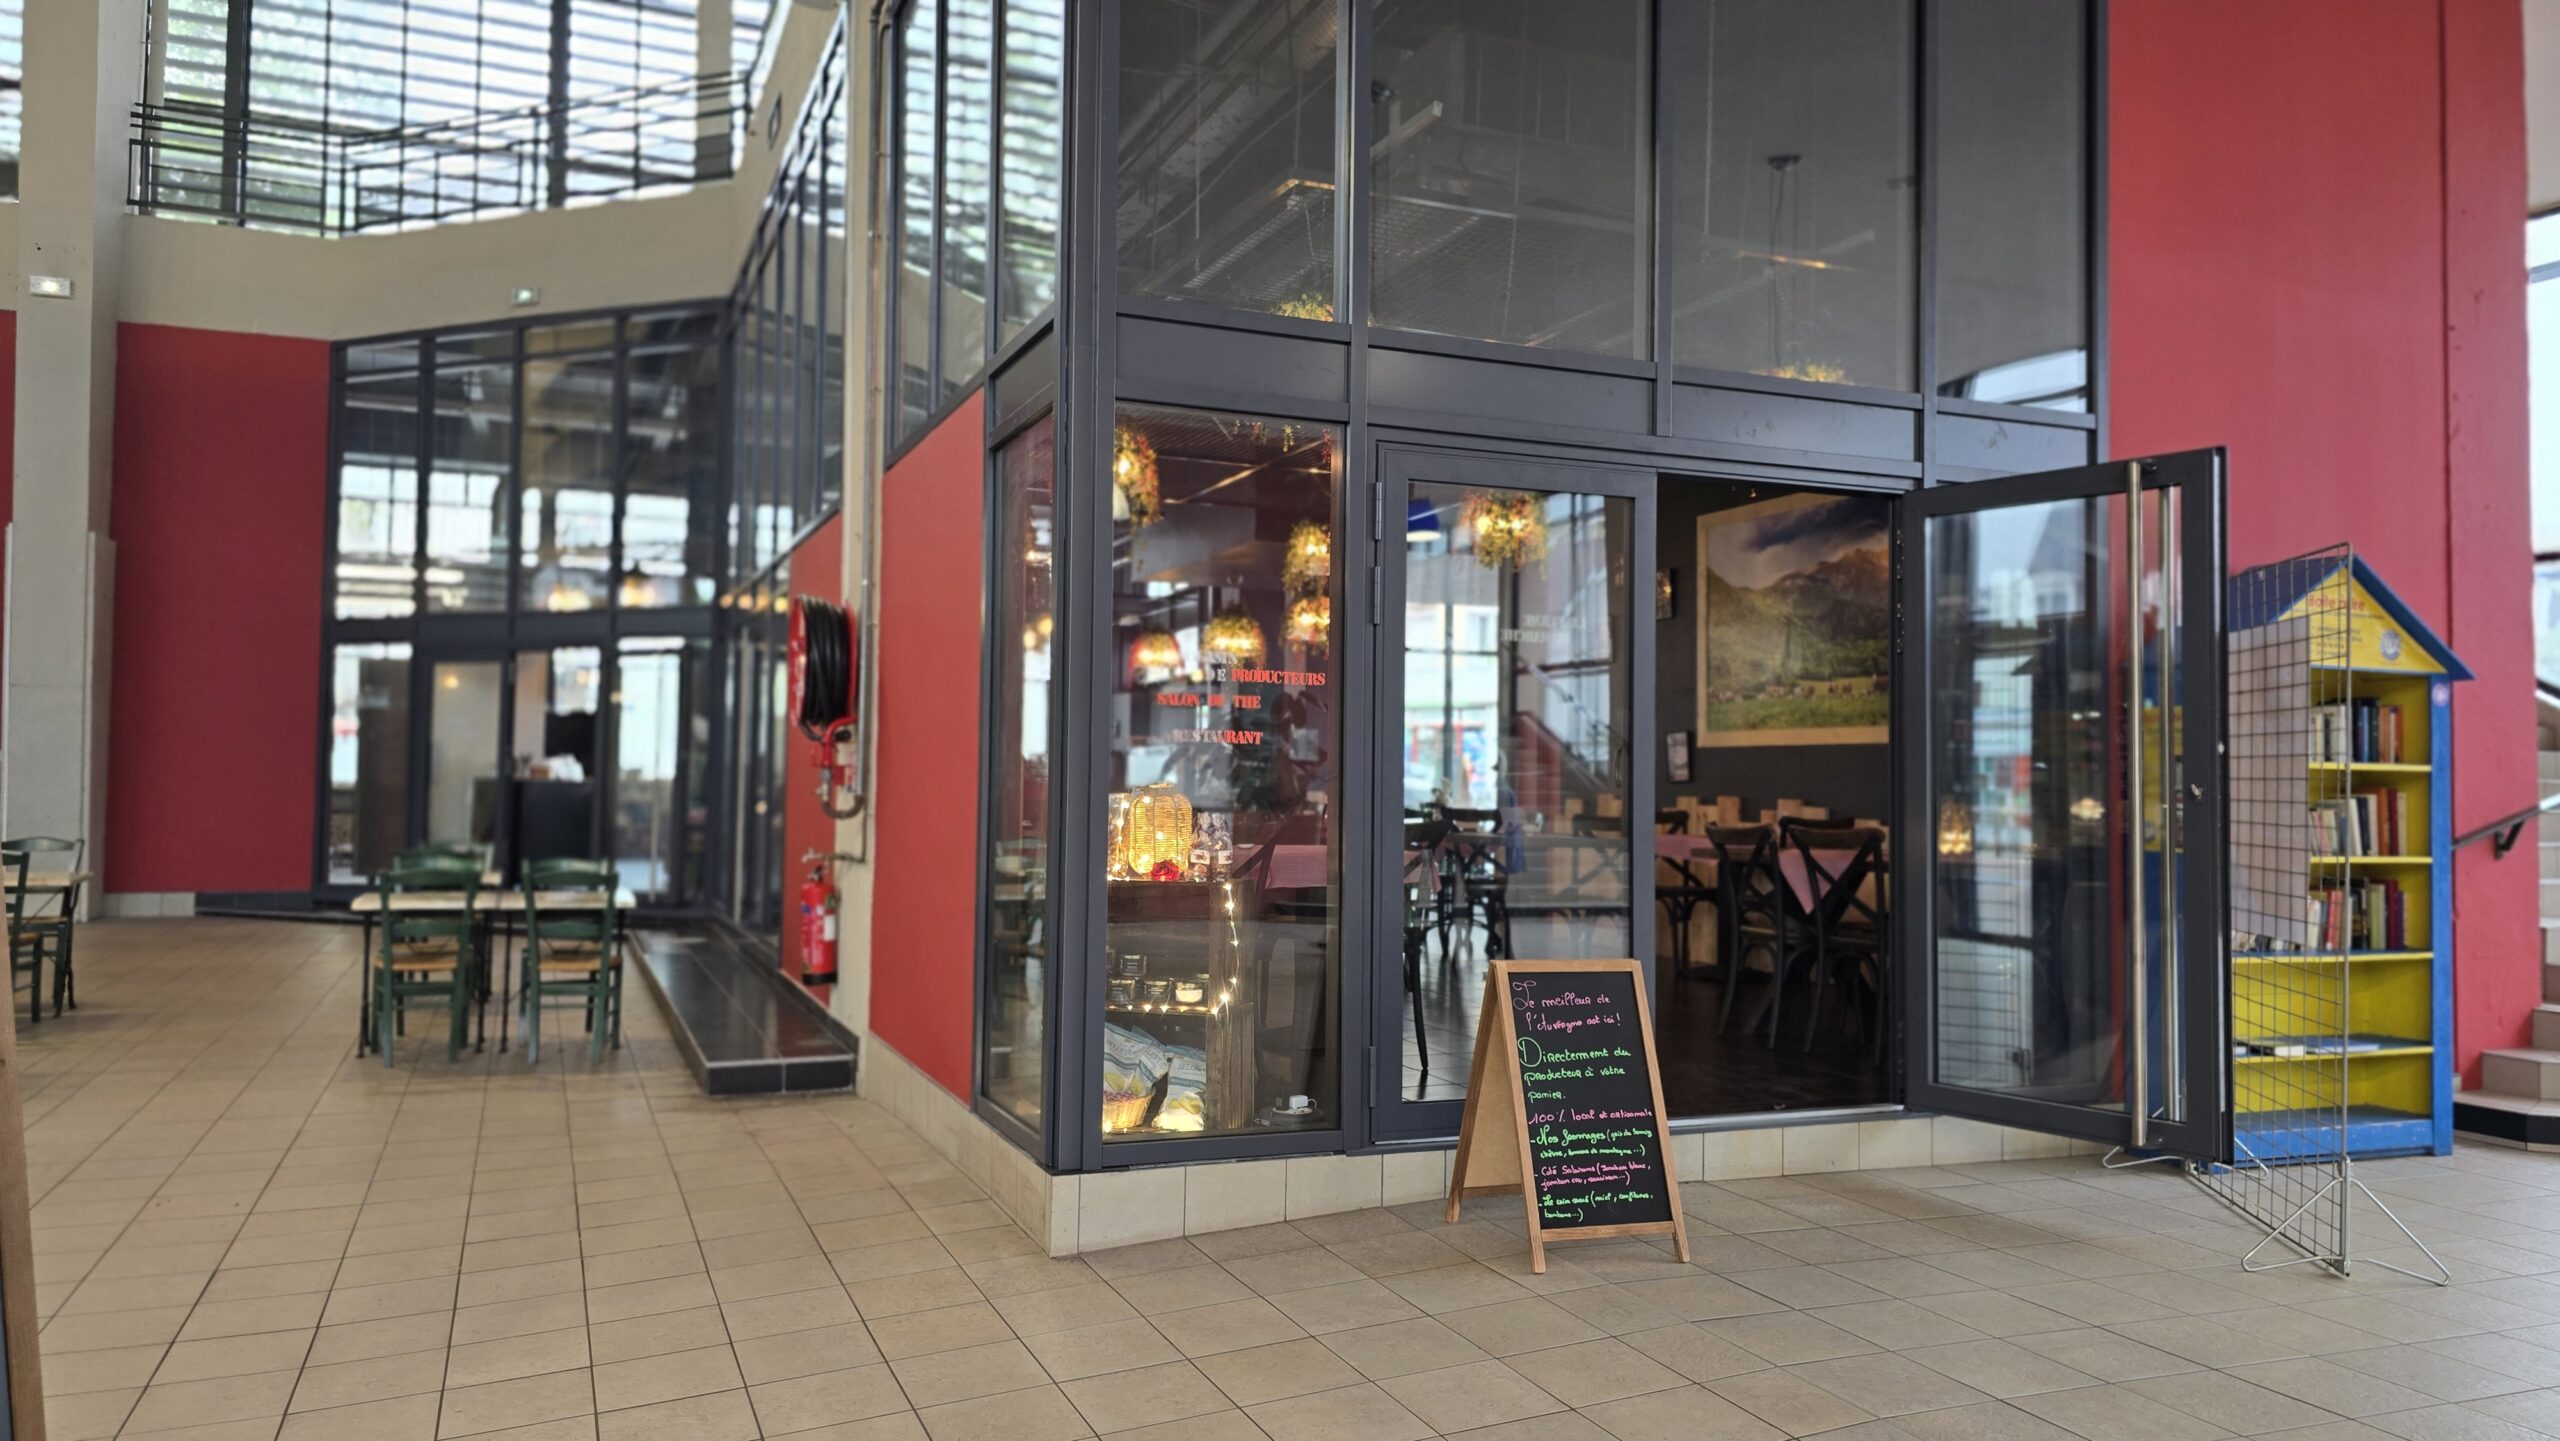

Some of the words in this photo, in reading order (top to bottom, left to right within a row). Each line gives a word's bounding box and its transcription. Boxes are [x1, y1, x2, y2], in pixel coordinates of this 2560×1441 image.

[1231, 668, 1327, 687] PRODUCTEURS
[1155, 692, 1202, 708] SALON
[1172, 728, 1265, 746] RESTAURANT
[1513, 980, 1537, 1010] Le
[1541, 992, 1592, 1008] meilleur
[1596, 993, 1612, 1005] de
[1586, 1015, 1601, 1026] est
[1517, 1036, 1610, 1068] Directement
[1613, 1047, 1632, 1057] du
[1523, 1068, 1583, 1087] producteur
[1584, 1066, 1595, 1078] à
[1600, 1066, 1626, 1077] votre
[1570, 1108, 1596, 1121] local
[1598, 1110, 1609, 1120] et
